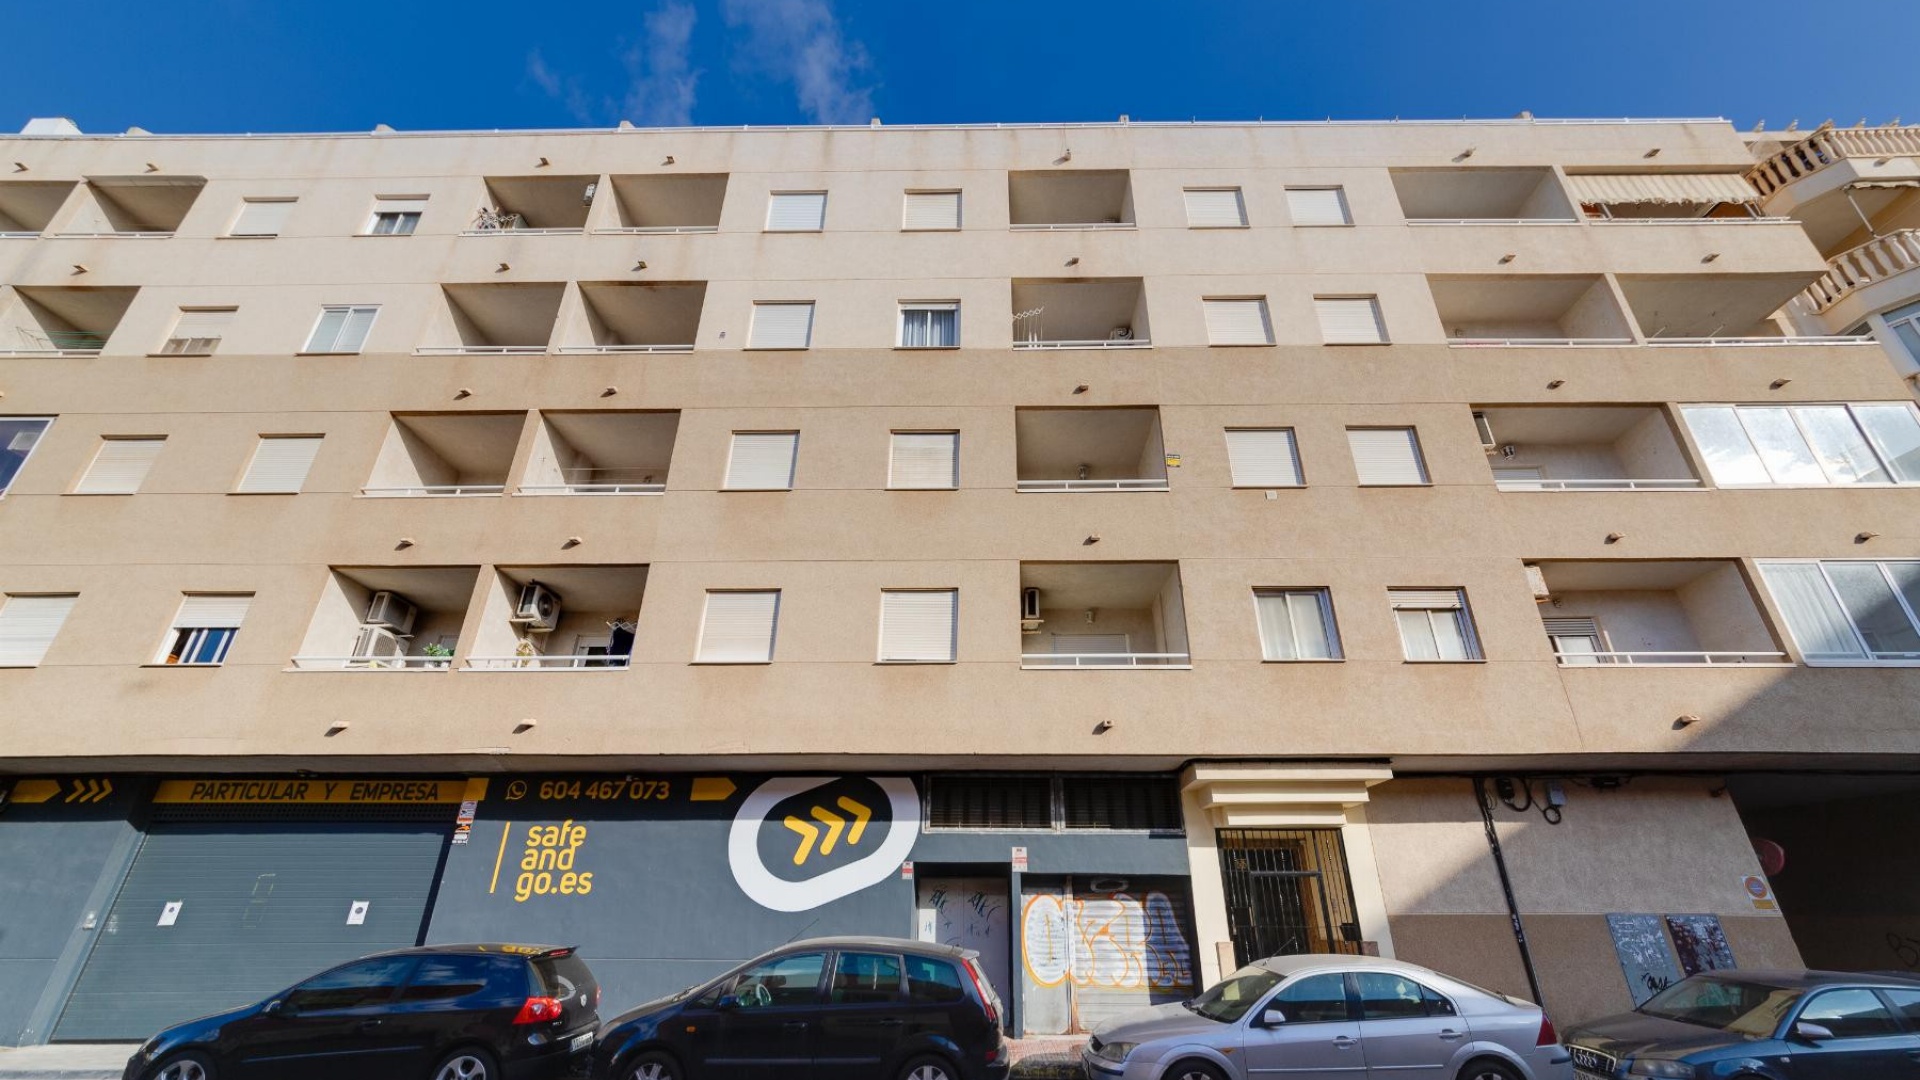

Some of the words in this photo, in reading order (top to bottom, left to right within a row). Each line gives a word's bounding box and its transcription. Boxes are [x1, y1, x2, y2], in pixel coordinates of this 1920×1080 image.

[190, 782, 309, 800] PARTICULAR
[324, 782, 338, 800] Y
[349, 782, 438, 800] EMPRESA
[539, 781, 580, 800] 604
[585, 781, 625, 800] 467
[629, 781, 669, 800] 073
[527, 819, 587, 847] safe
[521, 844, 576, 871] and
[514, 872, 593, 902] go.es
